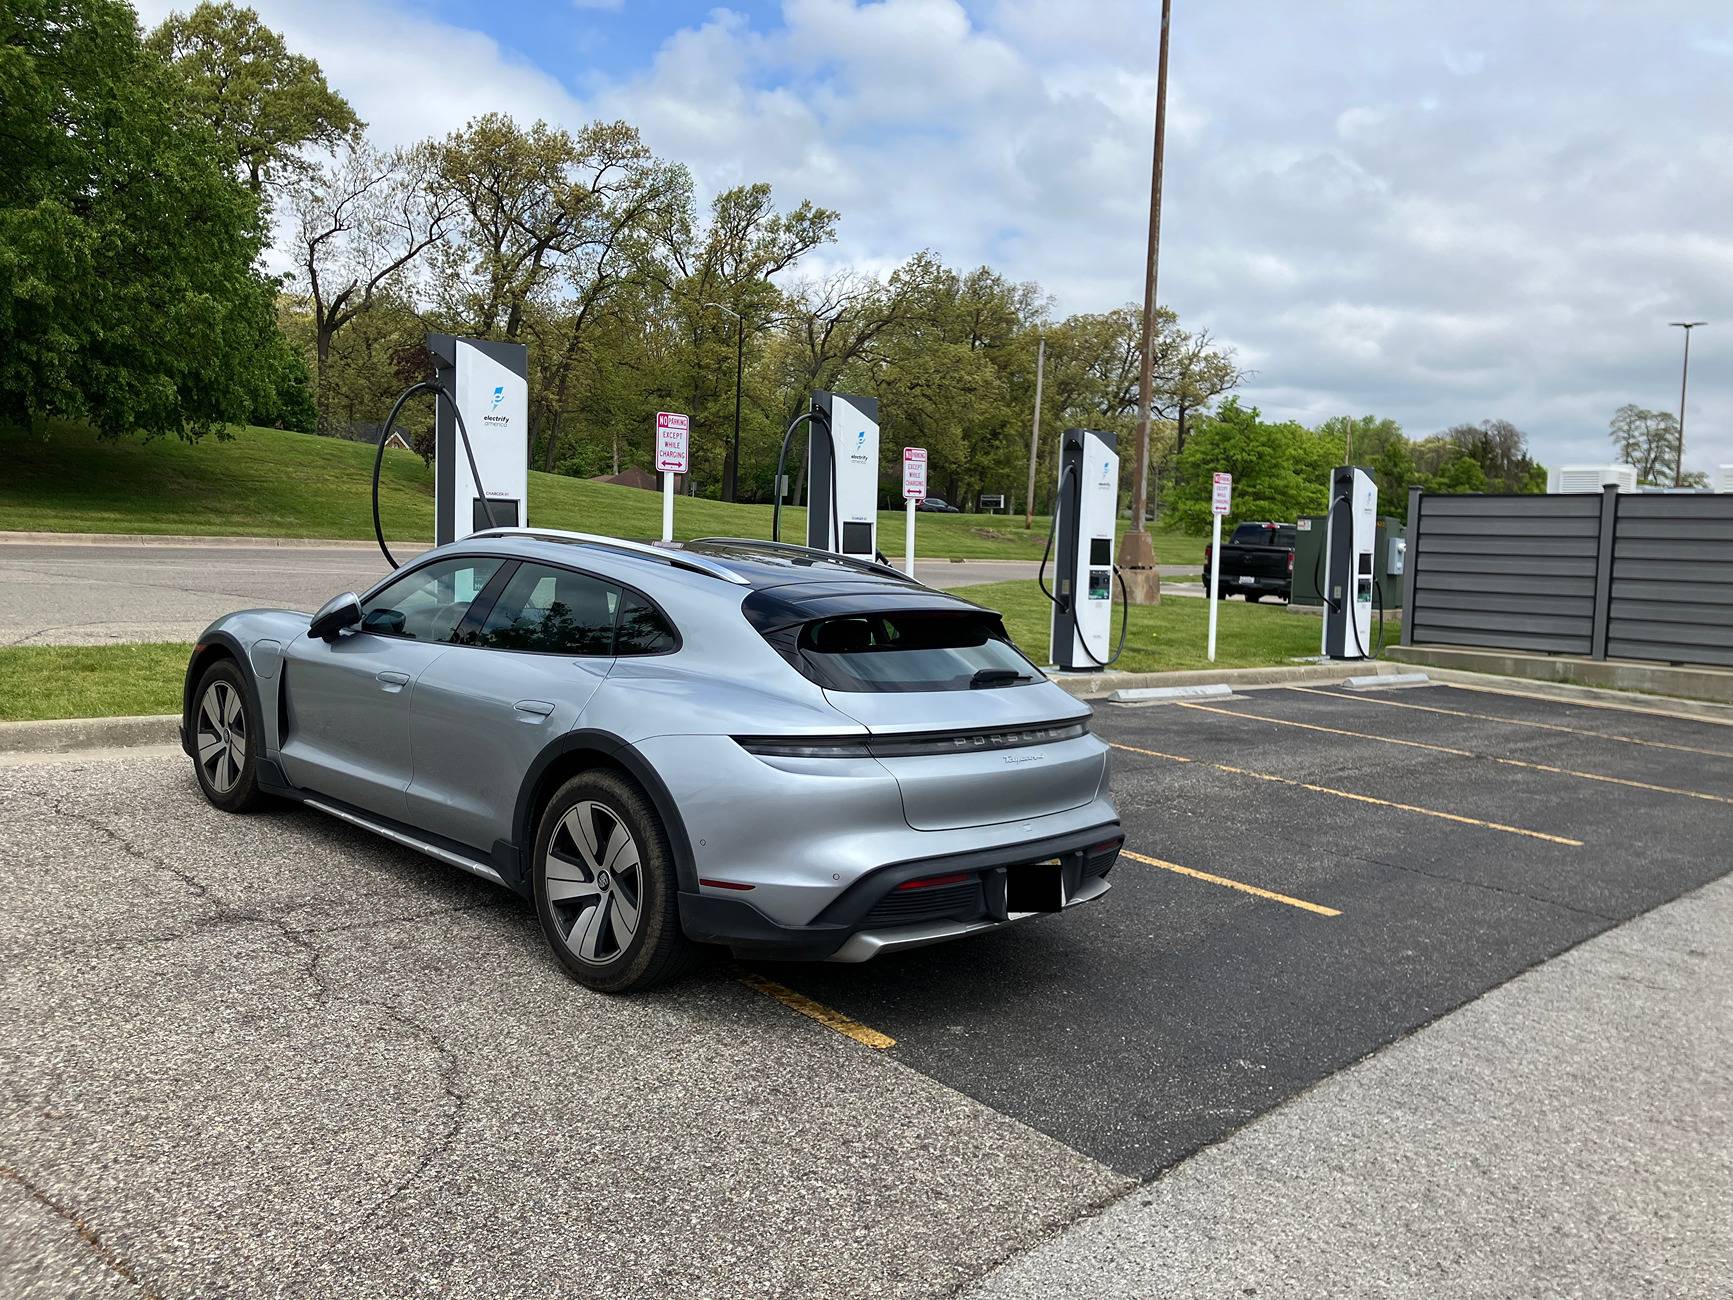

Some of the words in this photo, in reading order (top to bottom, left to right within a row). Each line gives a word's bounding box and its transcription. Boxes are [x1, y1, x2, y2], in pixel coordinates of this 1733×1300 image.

[483, 415, 510, 424] electrify
[660, 415, 668, 426] NO
[668, 417, 687, 427] PARKING
[662, 430, 683, 440] EXCEPT
[664, 441, 680, 449] WHILE
[659, 450, 686, 459] CHARGING
[953, 730, 1058, 746] PORSCHE
